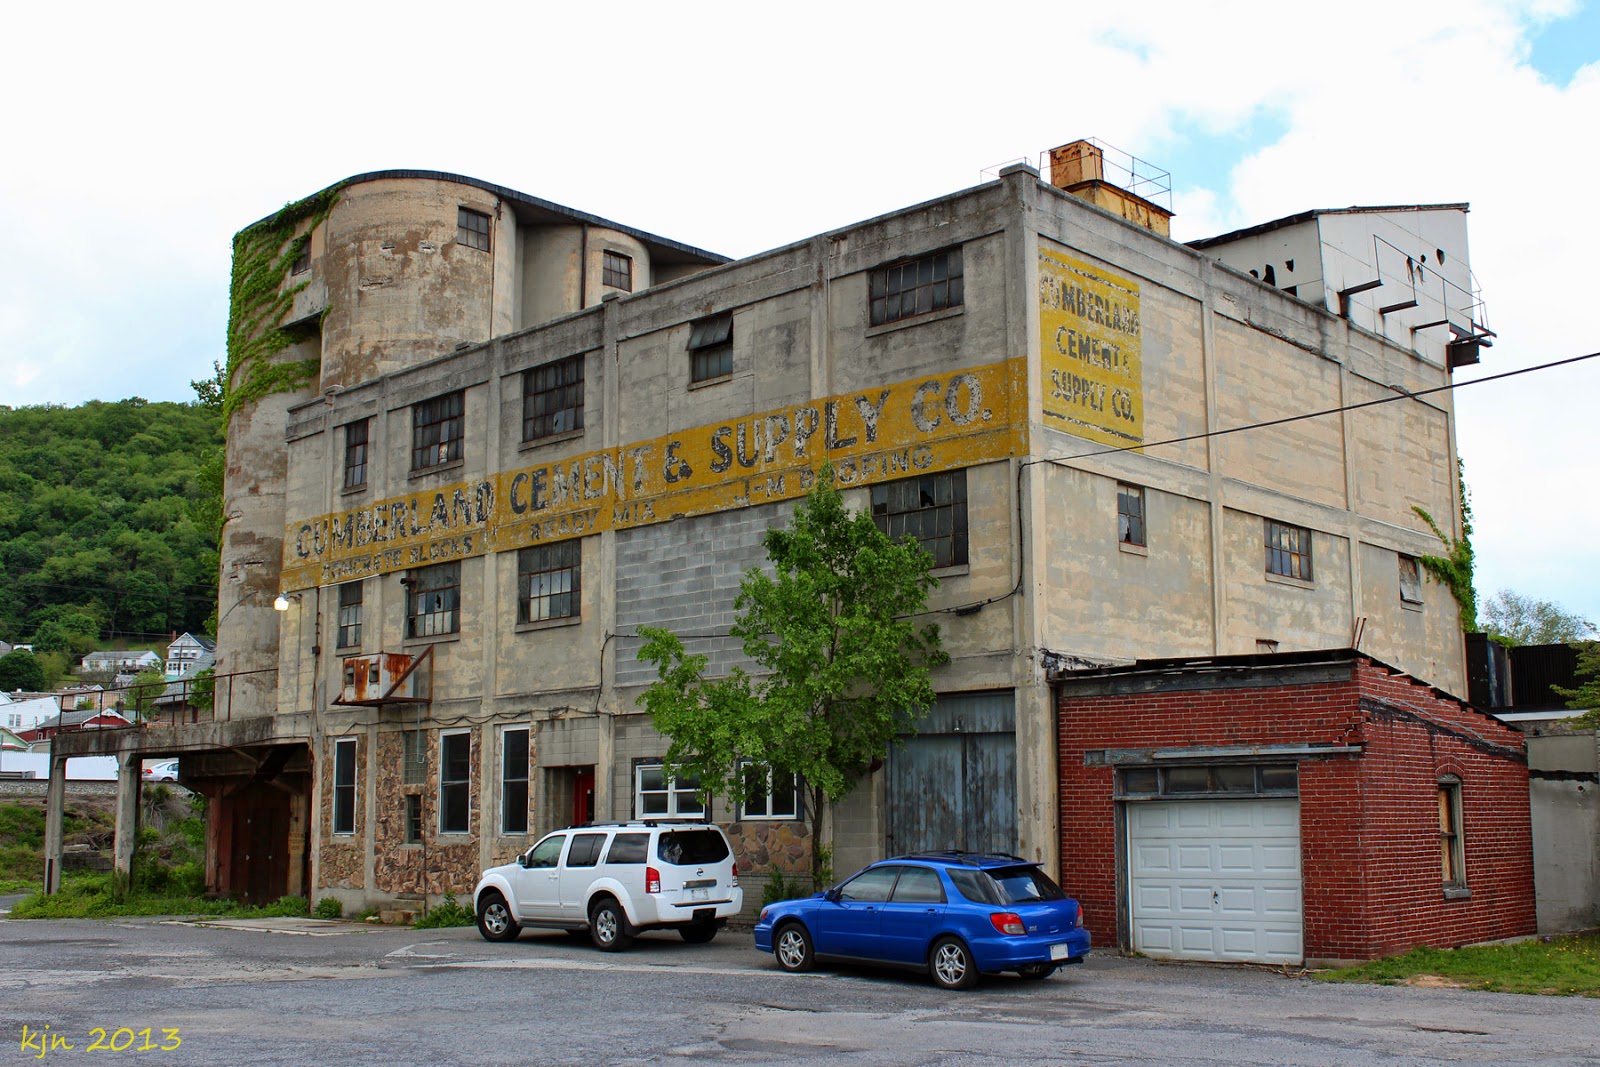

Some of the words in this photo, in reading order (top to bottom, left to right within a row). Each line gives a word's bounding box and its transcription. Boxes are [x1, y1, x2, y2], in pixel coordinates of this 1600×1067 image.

[1056, 325, 1120, 372] CEMENT
[1051, 368, 1106, 413] SUPPLY
[297, 481, 495, 559] CUMBERLAND
[510, 444, 652, 515] CEMENT
[663, 441, 693, 483] &
[711, 389, 891, 474] SUPPLY
[911, 373, 993, 433] CO.
[321, 549, 402, 581] CONCRETE
[410, 536, 473, 564] BLOCKS
[530, 508, 600, 541] READY
[611, 500, 656, 525] MIX
